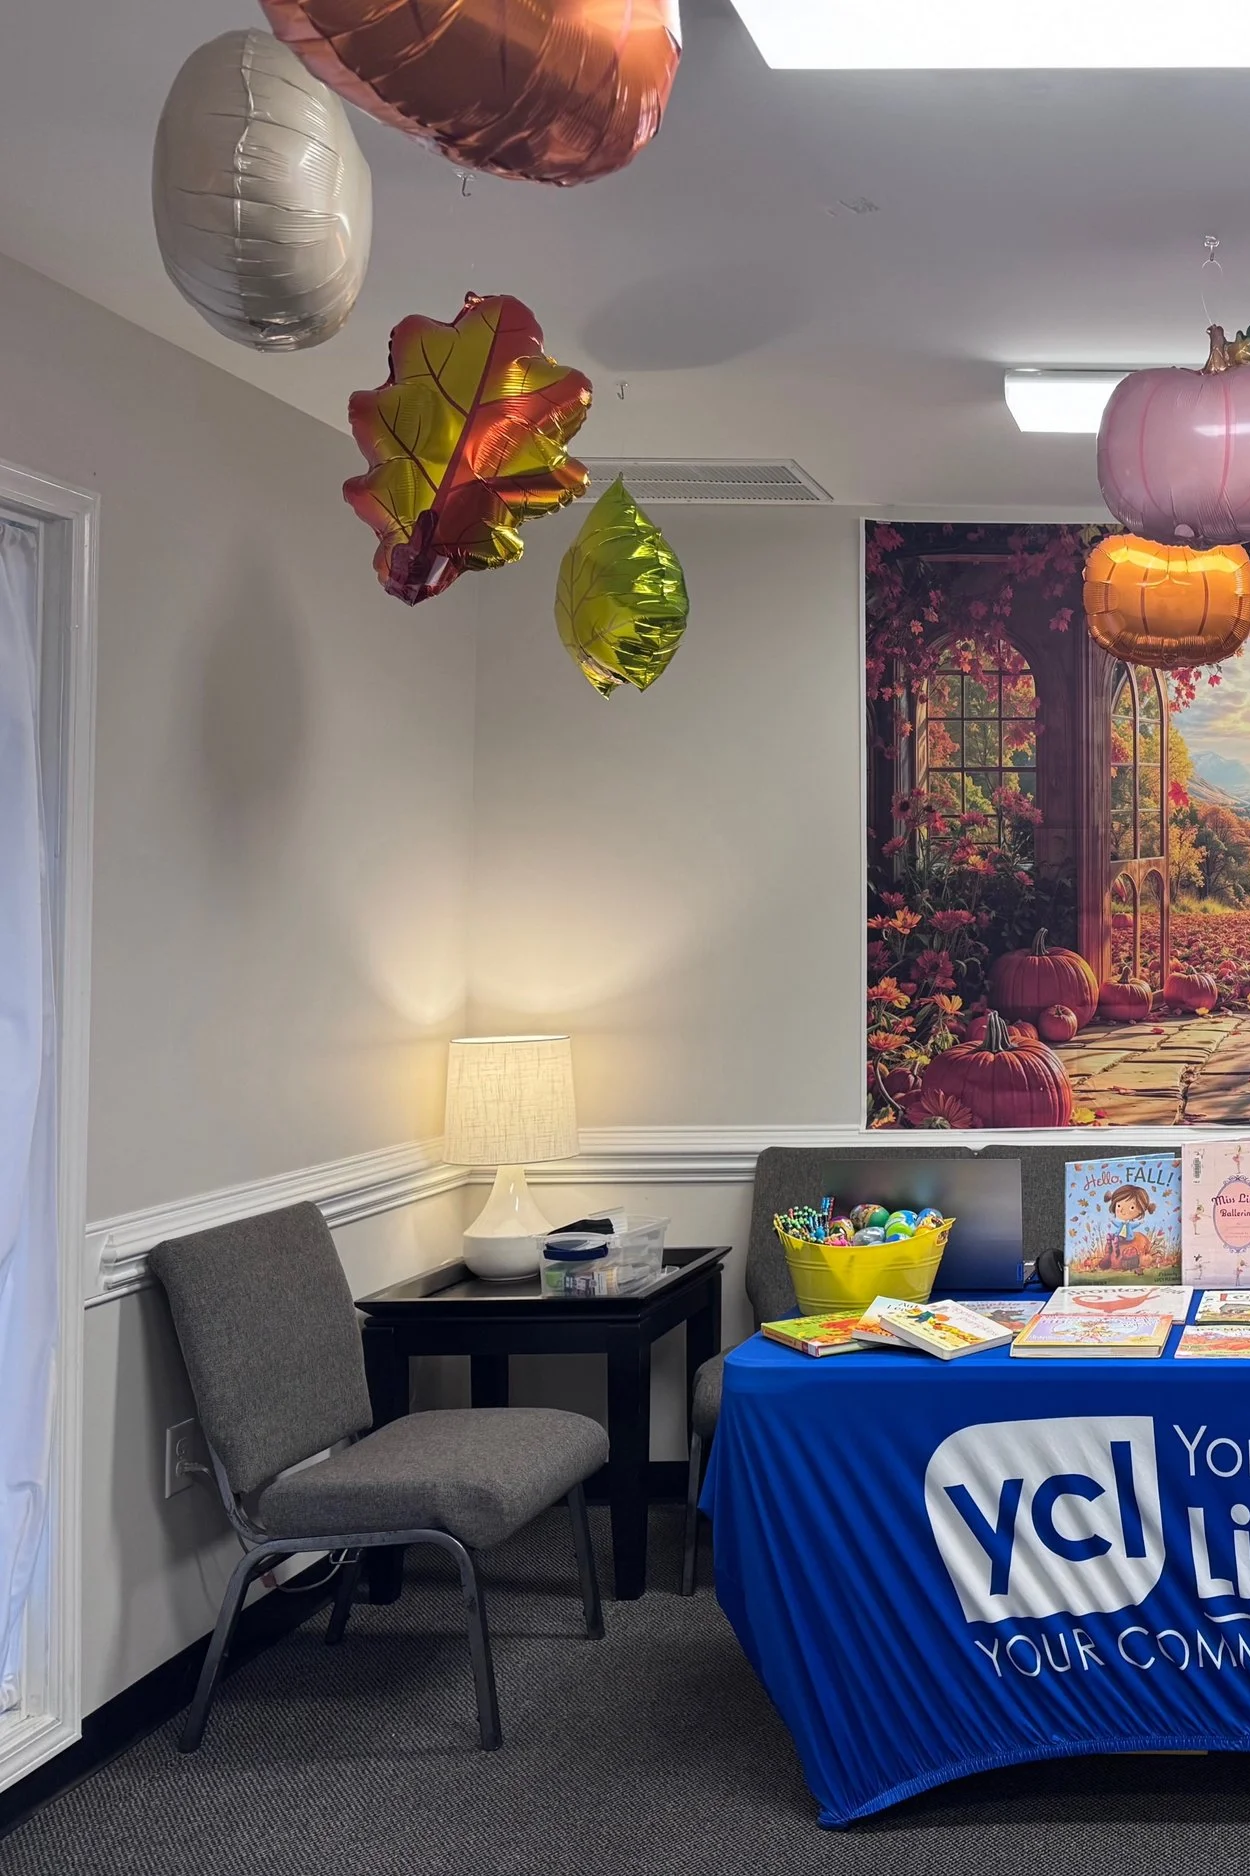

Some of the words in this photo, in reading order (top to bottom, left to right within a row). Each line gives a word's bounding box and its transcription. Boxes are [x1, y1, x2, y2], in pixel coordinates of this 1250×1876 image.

[1083, 1171, 1122, 1191] Hello,
[1126, 1167, 1174, 1187] FALL!
[1211, 1195, 1236, 1206] Miss
[944, 1440, 1148, 1597] ycl
[974, 1628, 1106, 1679] YOUR
